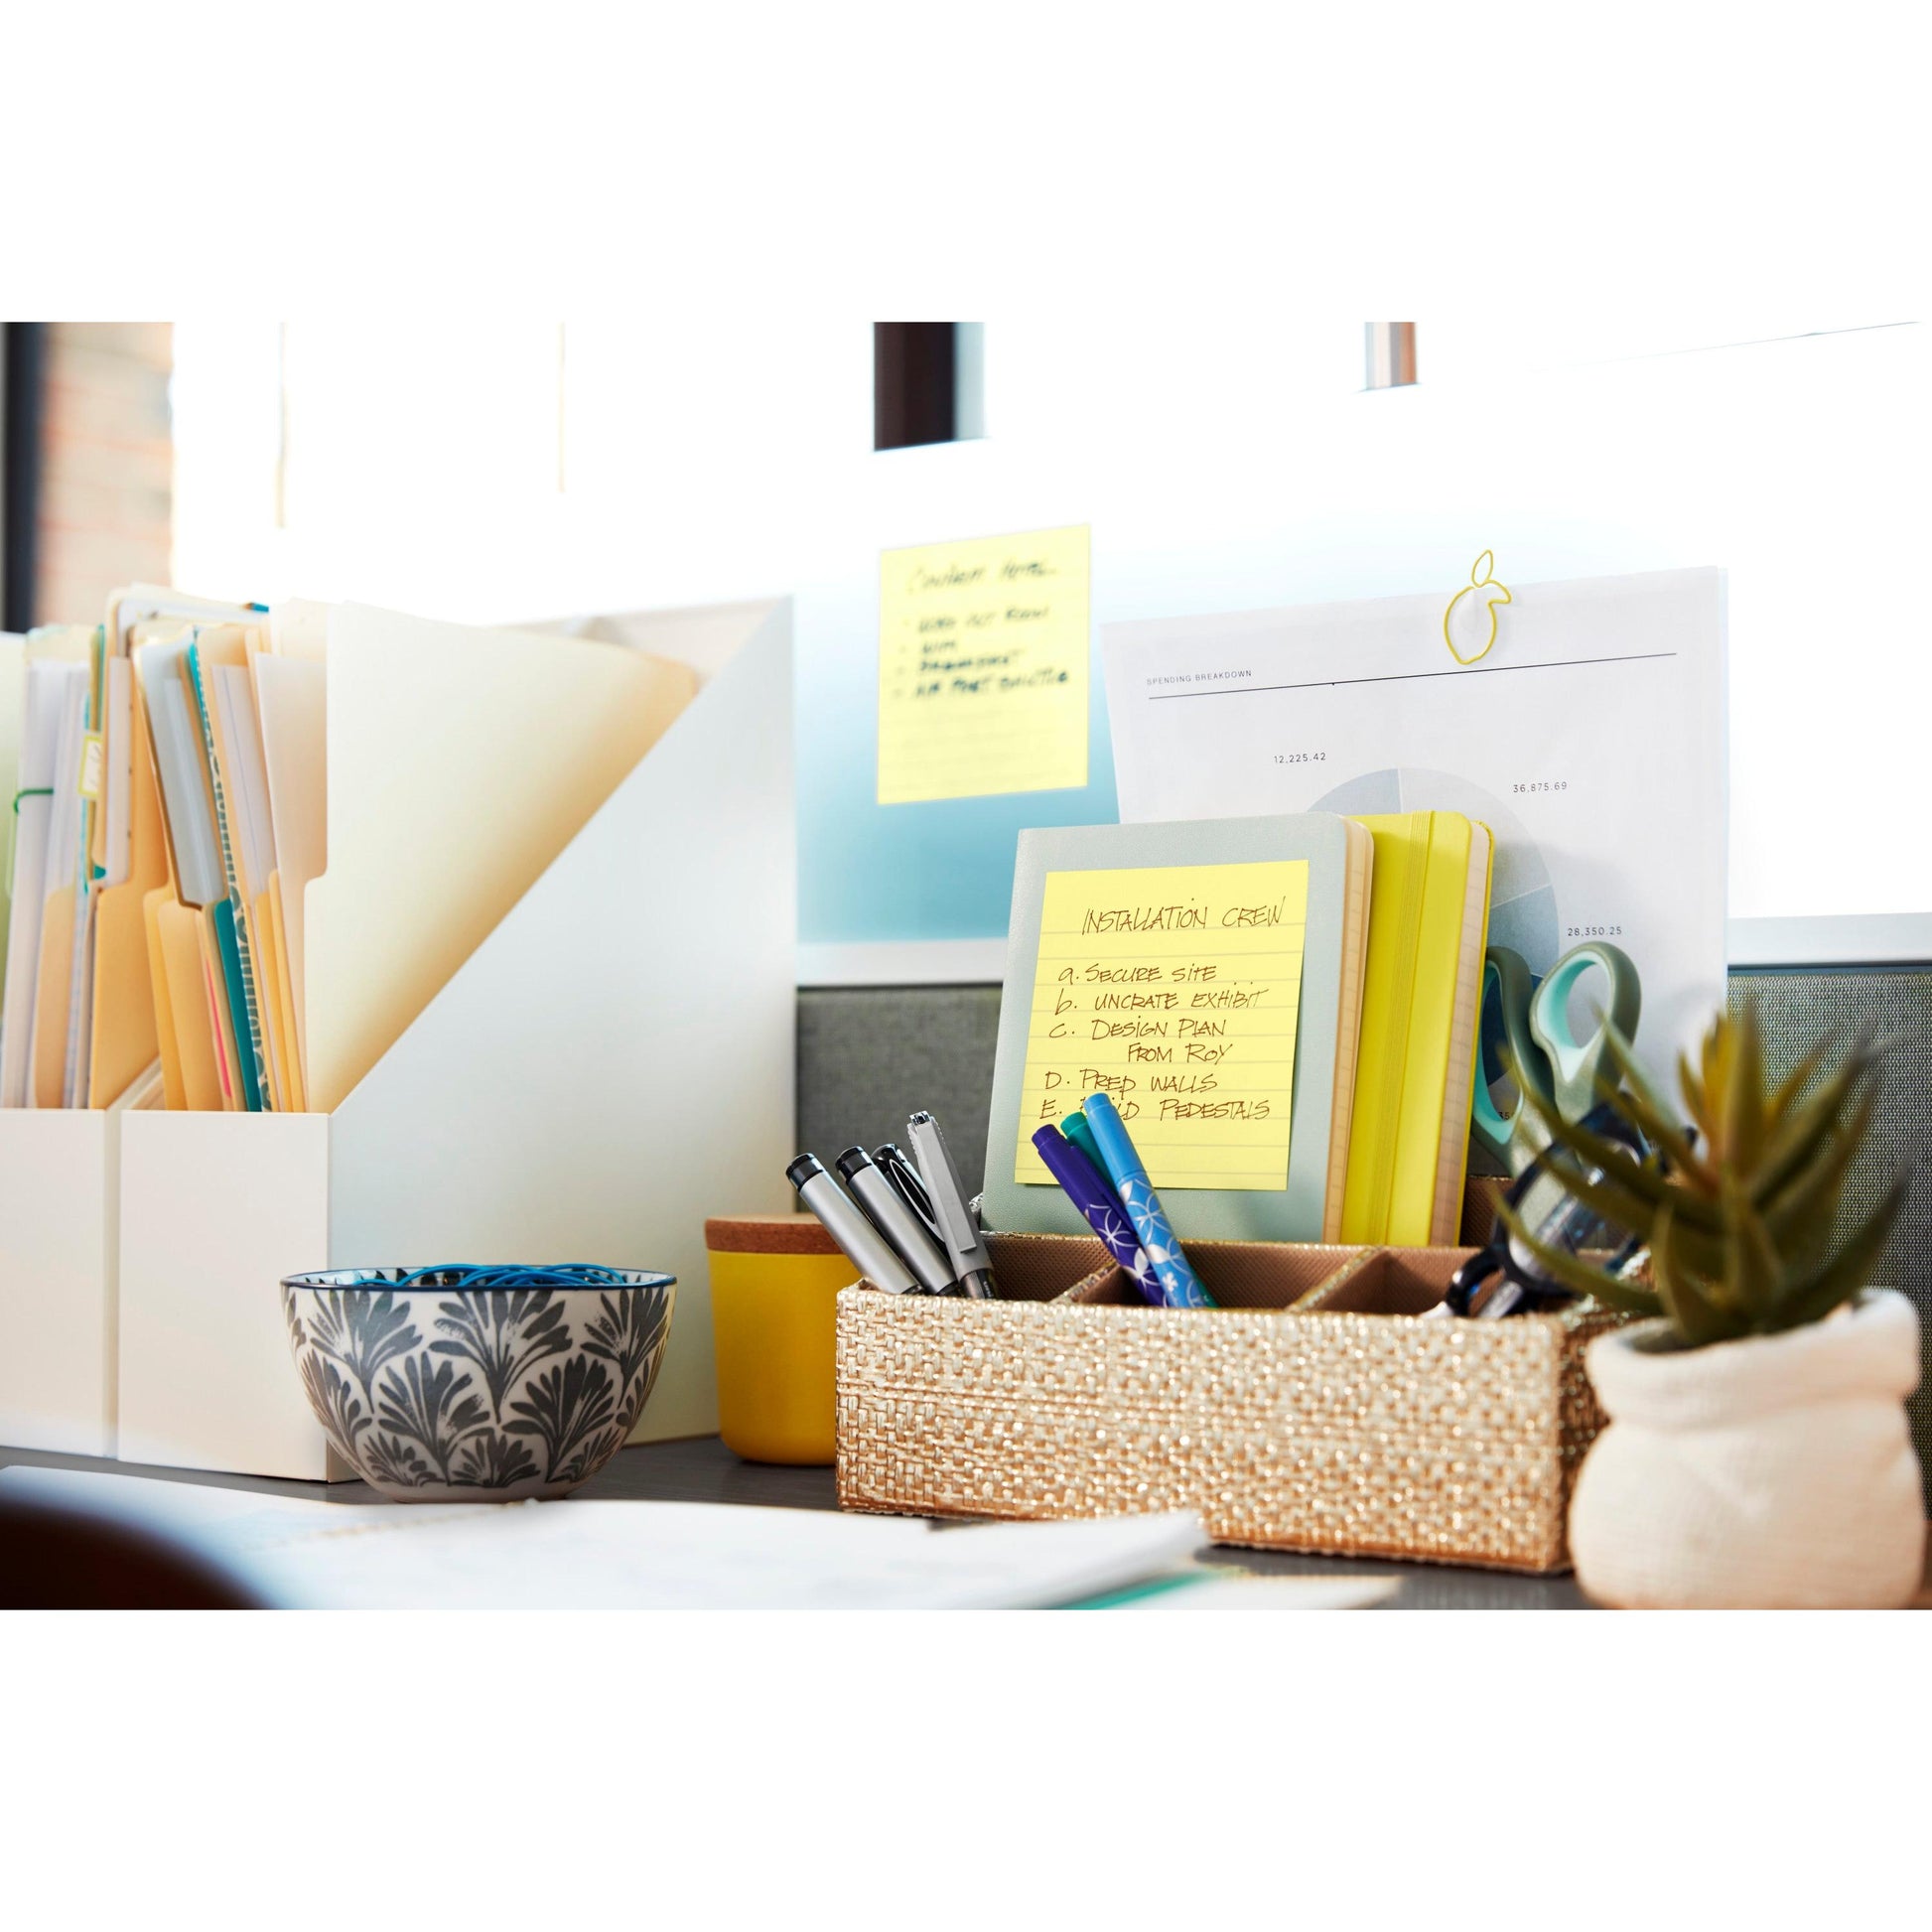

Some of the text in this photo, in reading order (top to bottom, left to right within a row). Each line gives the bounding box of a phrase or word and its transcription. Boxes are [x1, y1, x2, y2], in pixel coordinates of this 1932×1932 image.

[1147, 670, 1252, 685] SPENDING BREAKDOWN
[1274, 752, 1326, 763] 12,225.42
[1513, 781, 1568, 793] 36,875.69
[1221, 896, 1286, 928] CREW
[1568, 925, 1622, 937] 28,350.25
[1085, 963, 1163, 983] SECURE
[1054, 988, 1077, 1016] b.
[1094, 992, 1178, 1011] UNCRATE
[1177, 1018, 1227, 1038] PLAN
[1128, 1042, 1173, 1063] FROM
[1044, 1071, 1070, 1090] D.
[1151, 1073, 1218, 1093] WALLS
[1039, 1099, 1063, 1120] E.
[1160, 1098, 1271, 1122] PEDESTALS
